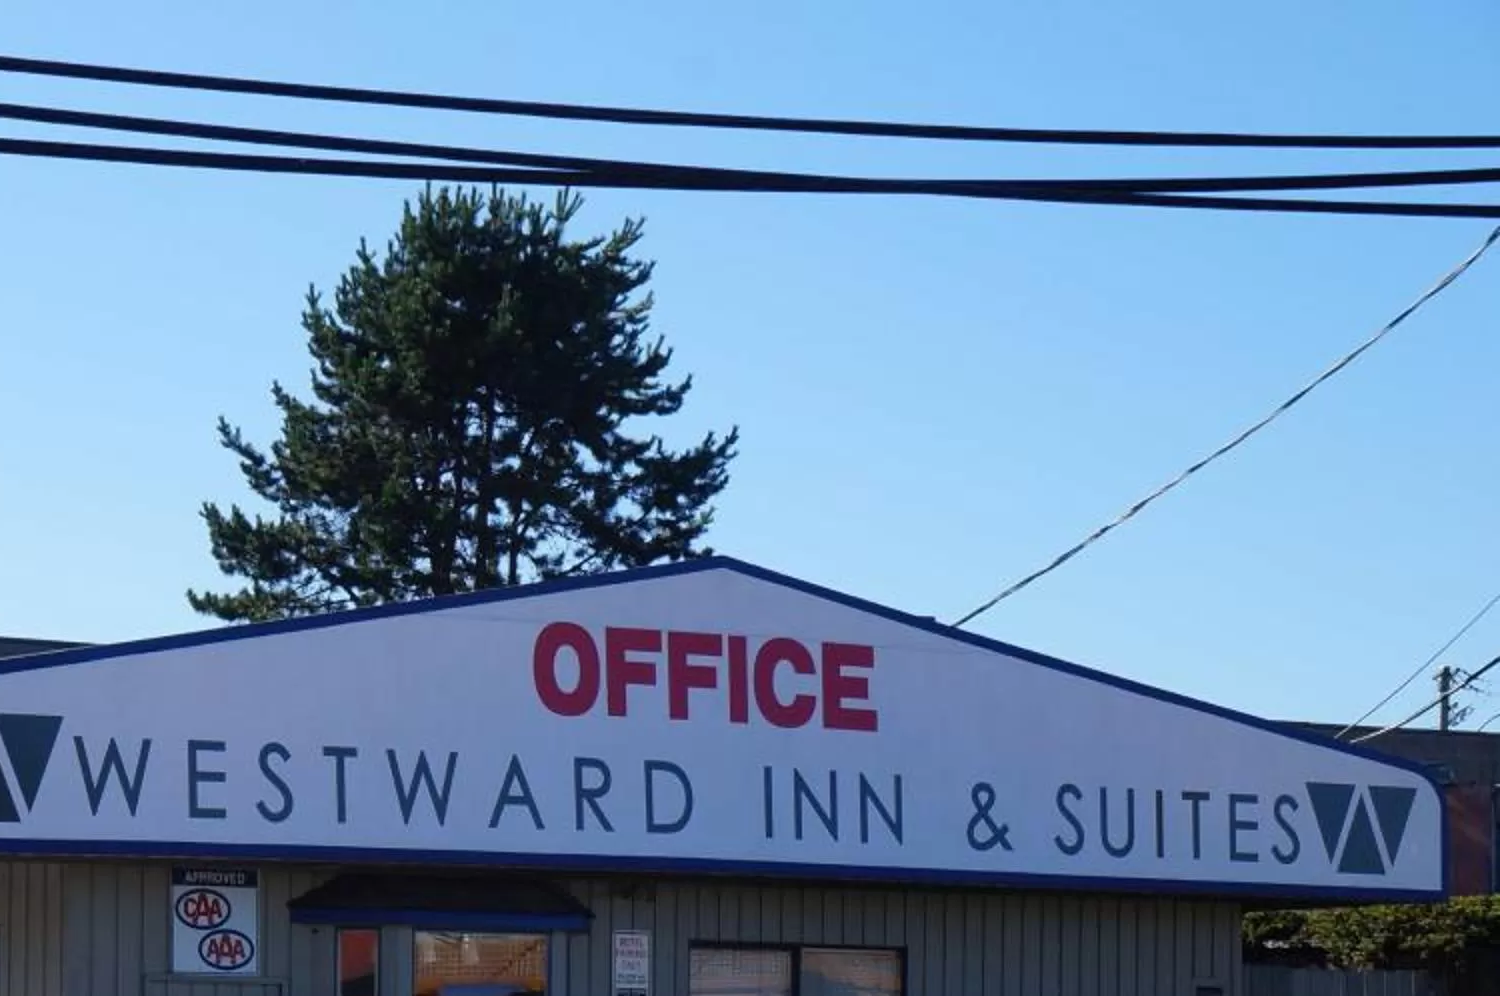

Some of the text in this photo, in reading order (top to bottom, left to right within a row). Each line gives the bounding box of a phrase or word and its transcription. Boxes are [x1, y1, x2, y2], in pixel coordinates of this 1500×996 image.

[533, 620, 879, 732] OFFICE
[72, 735, 1302, 867] WESTWARD INN & SUITES
[185, 870, 246, 885] APPROVED
[183, 892, 223, 926] CAA
[206, 932, 247, 965] AAA
